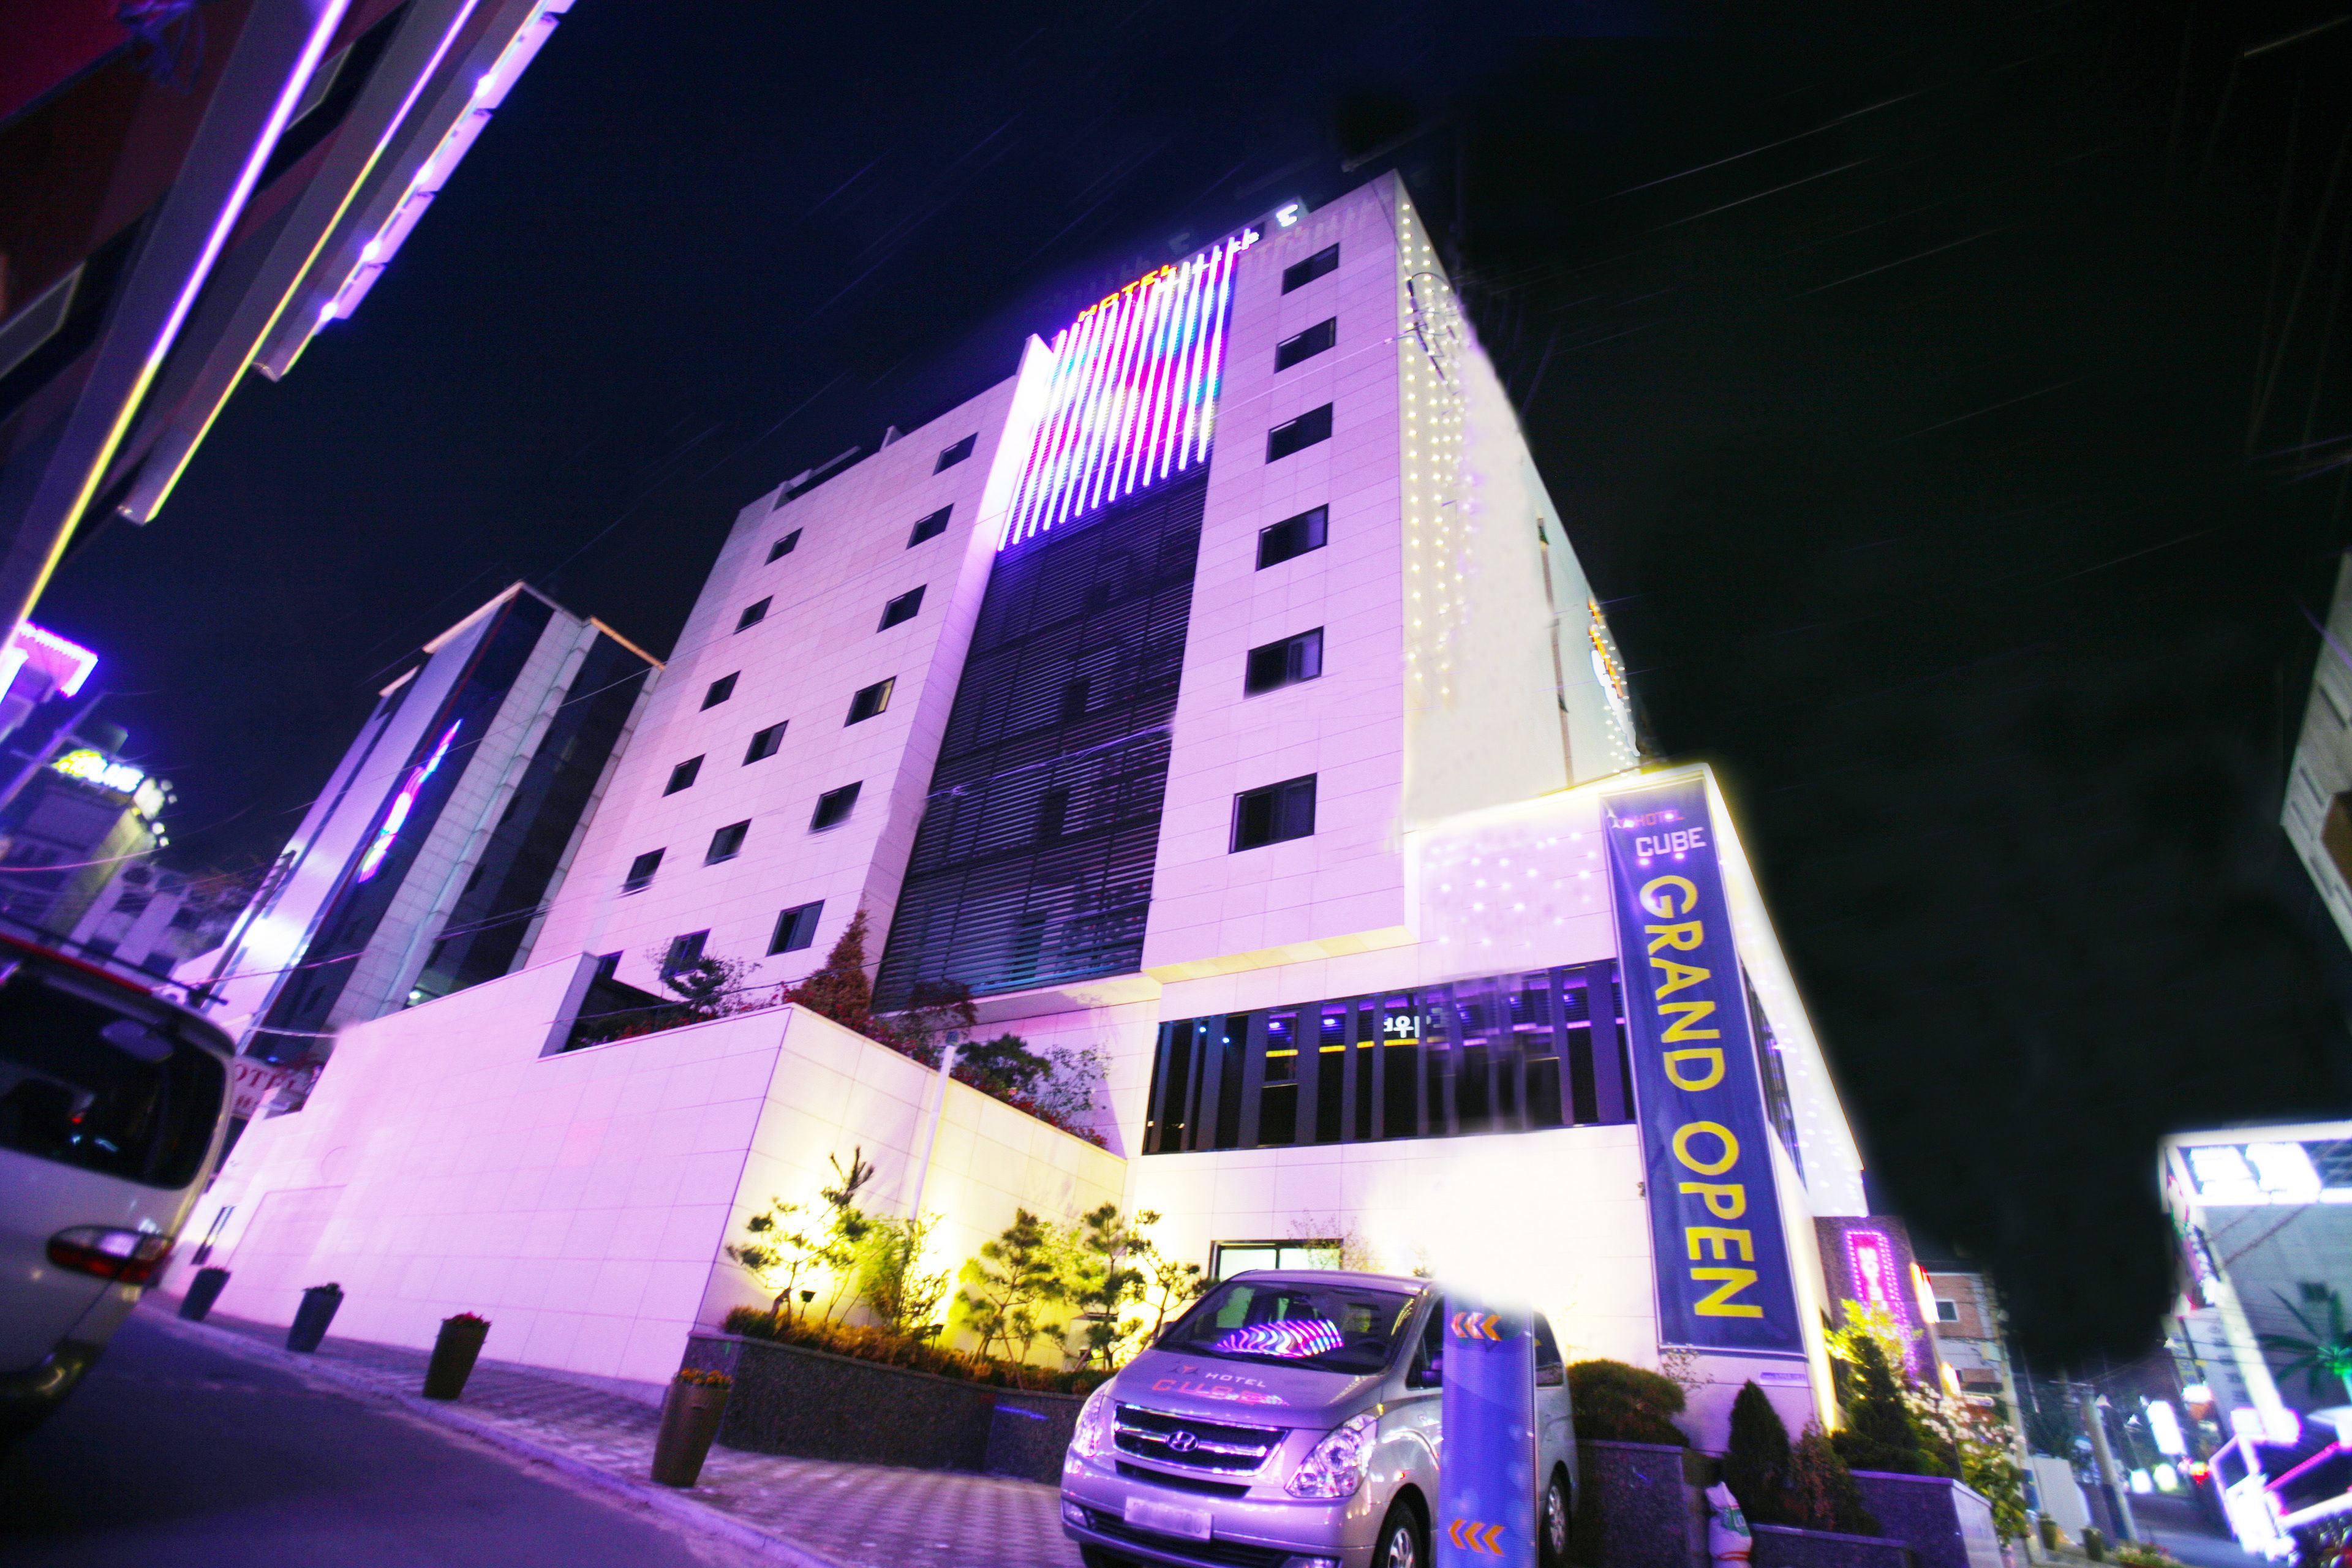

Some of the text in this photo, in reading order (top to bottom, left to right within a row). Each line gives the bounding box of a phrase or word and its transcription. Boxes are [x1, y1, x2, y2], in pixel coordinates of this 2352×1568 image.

[1635, 826, 1708, 857] CUBE
[1640, 875, 1764, 1319] GRAND OPEN
[1205, 1373, 1266, 1388] HOTEL
